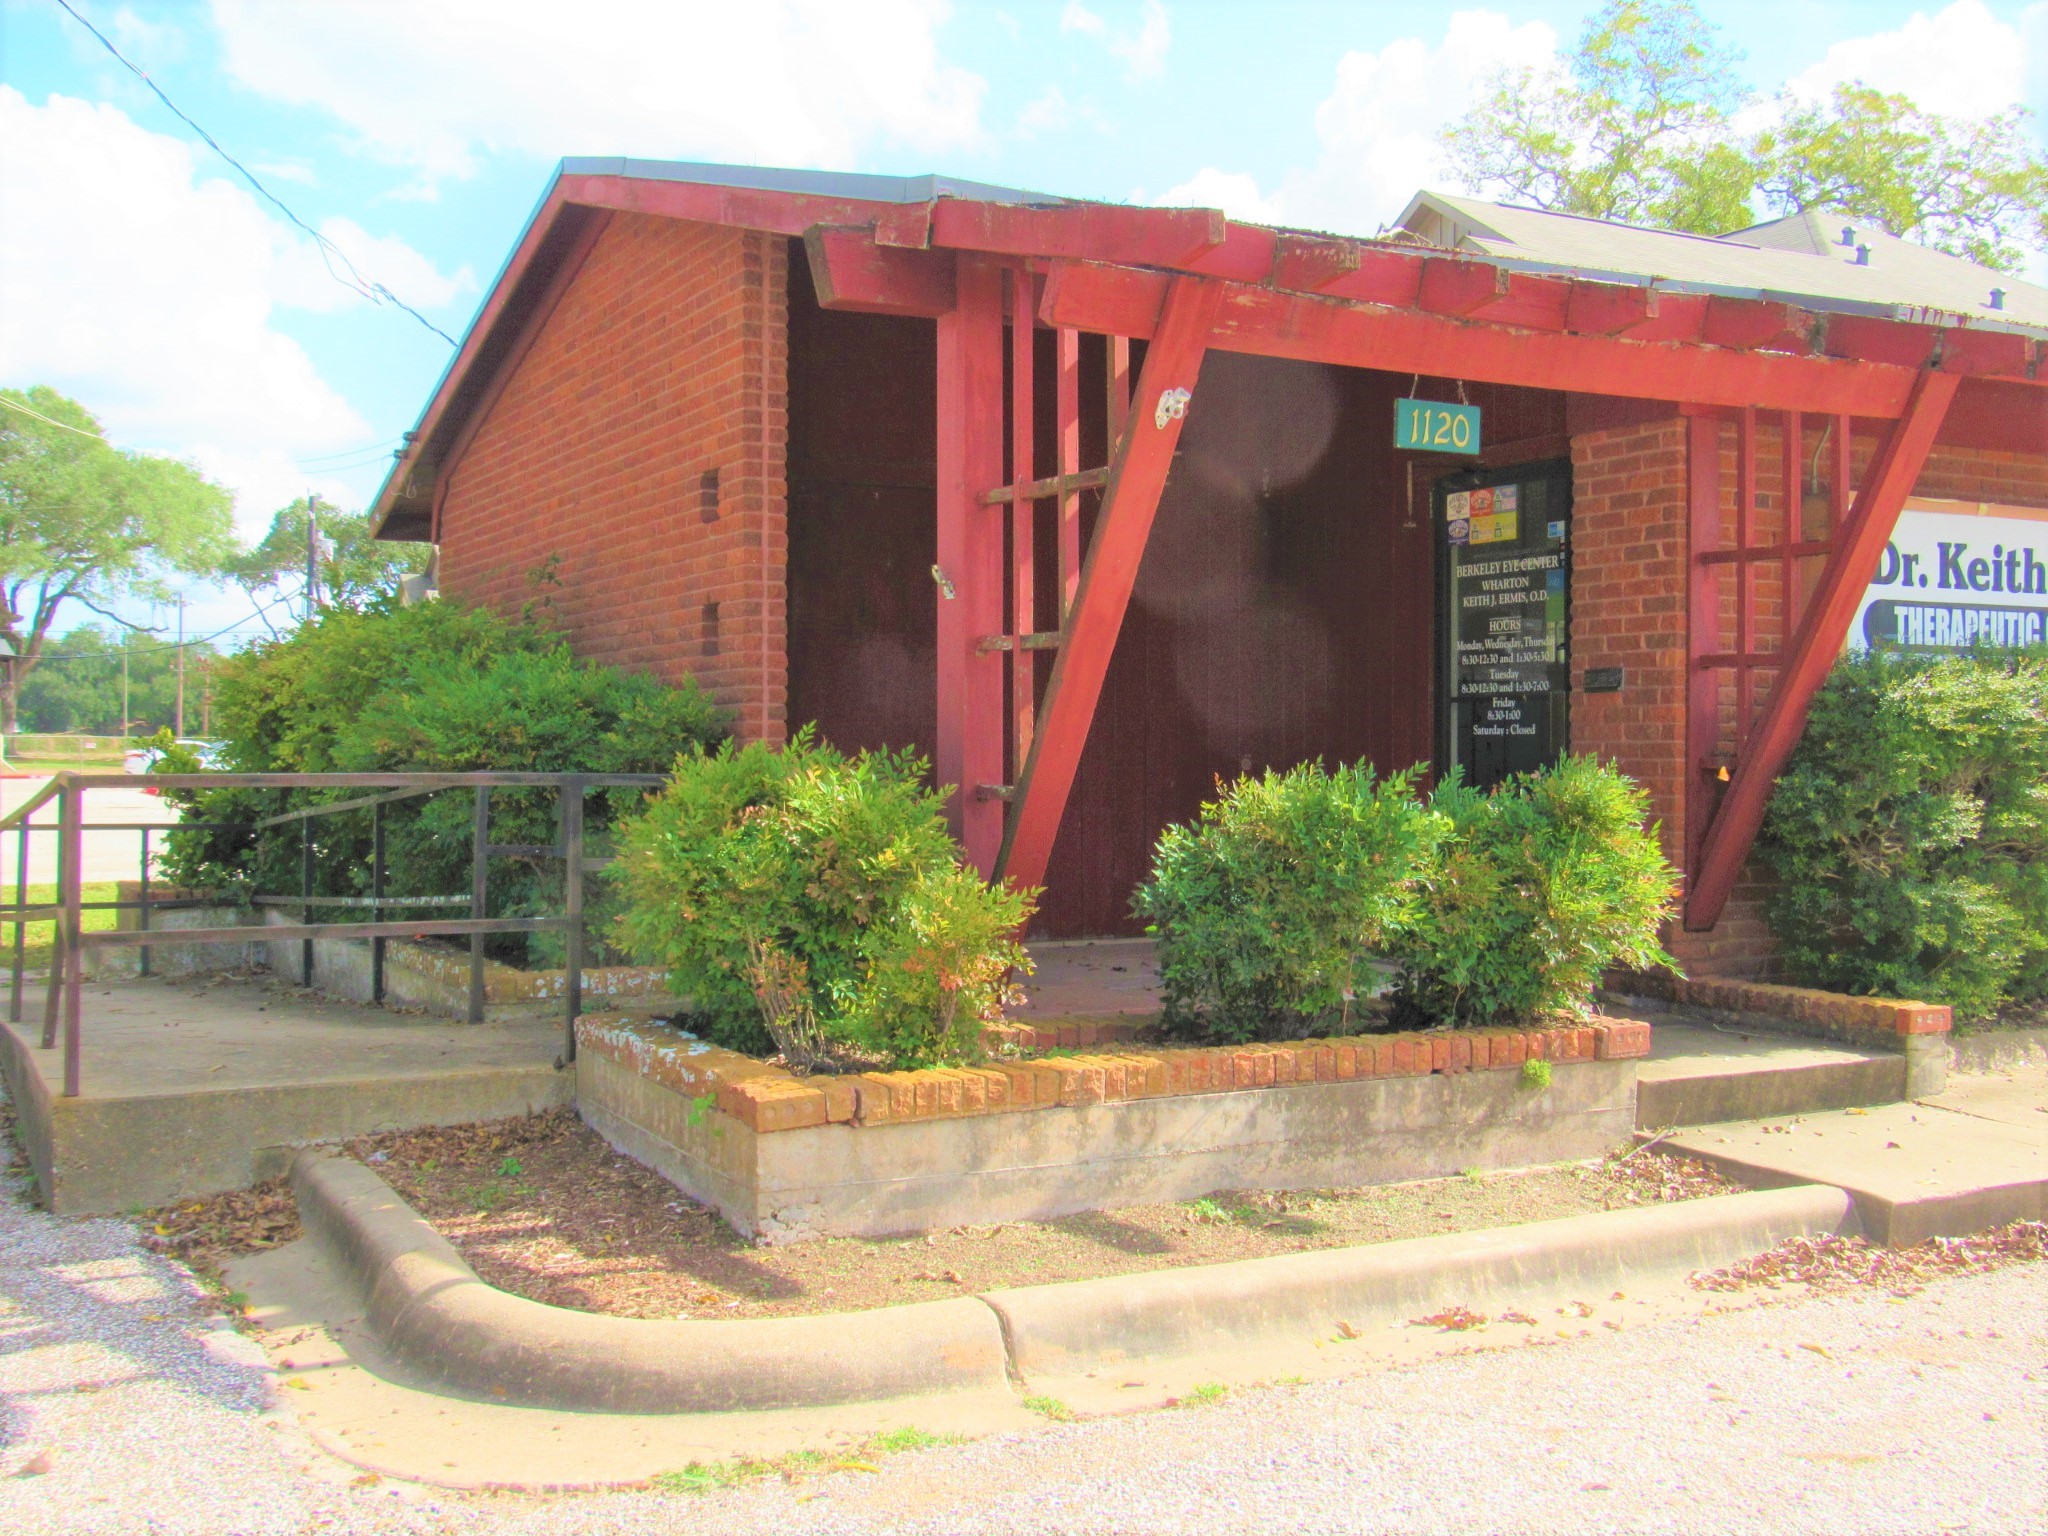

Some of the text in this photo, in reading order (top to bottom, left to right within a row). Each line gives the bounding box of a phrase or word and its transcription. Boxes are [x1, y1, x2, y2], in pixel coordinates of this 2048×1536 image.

[1410, 409, 1470, 448] 1120
[1456, 555, 1559, 578] BERKELEY EYE CENTER
[1869, 540, 2048, 594] Dr. Keith
[1482, 576, 1529, 591] WHARTON
[1463, 590, 1549, 608] KEITH J. ERMIS, O.D.
[1489, 620, 1520, 632] HOURS
[1894, 605, 2040, 648] THERAPEUTIC
[1456, 641, 1484, 652] Monday,
[1485, 637, 1523, 650] Wednesday,
[1462, 651, 1550, 665] 8:30-12:30 and 1:30-5:30
[1490, 669, 1519, 680] Tuesday
[1461, 681, 1549, 694] 8:30-12:30 and 1:30-7:00
[1492, 697, 1516, 709] Friday
[1487, 710, 1520, 721] 8:30-1:00
[1473, 724, 1504, 736] Saturday
[1510, 723, 1536, 735] Closed
